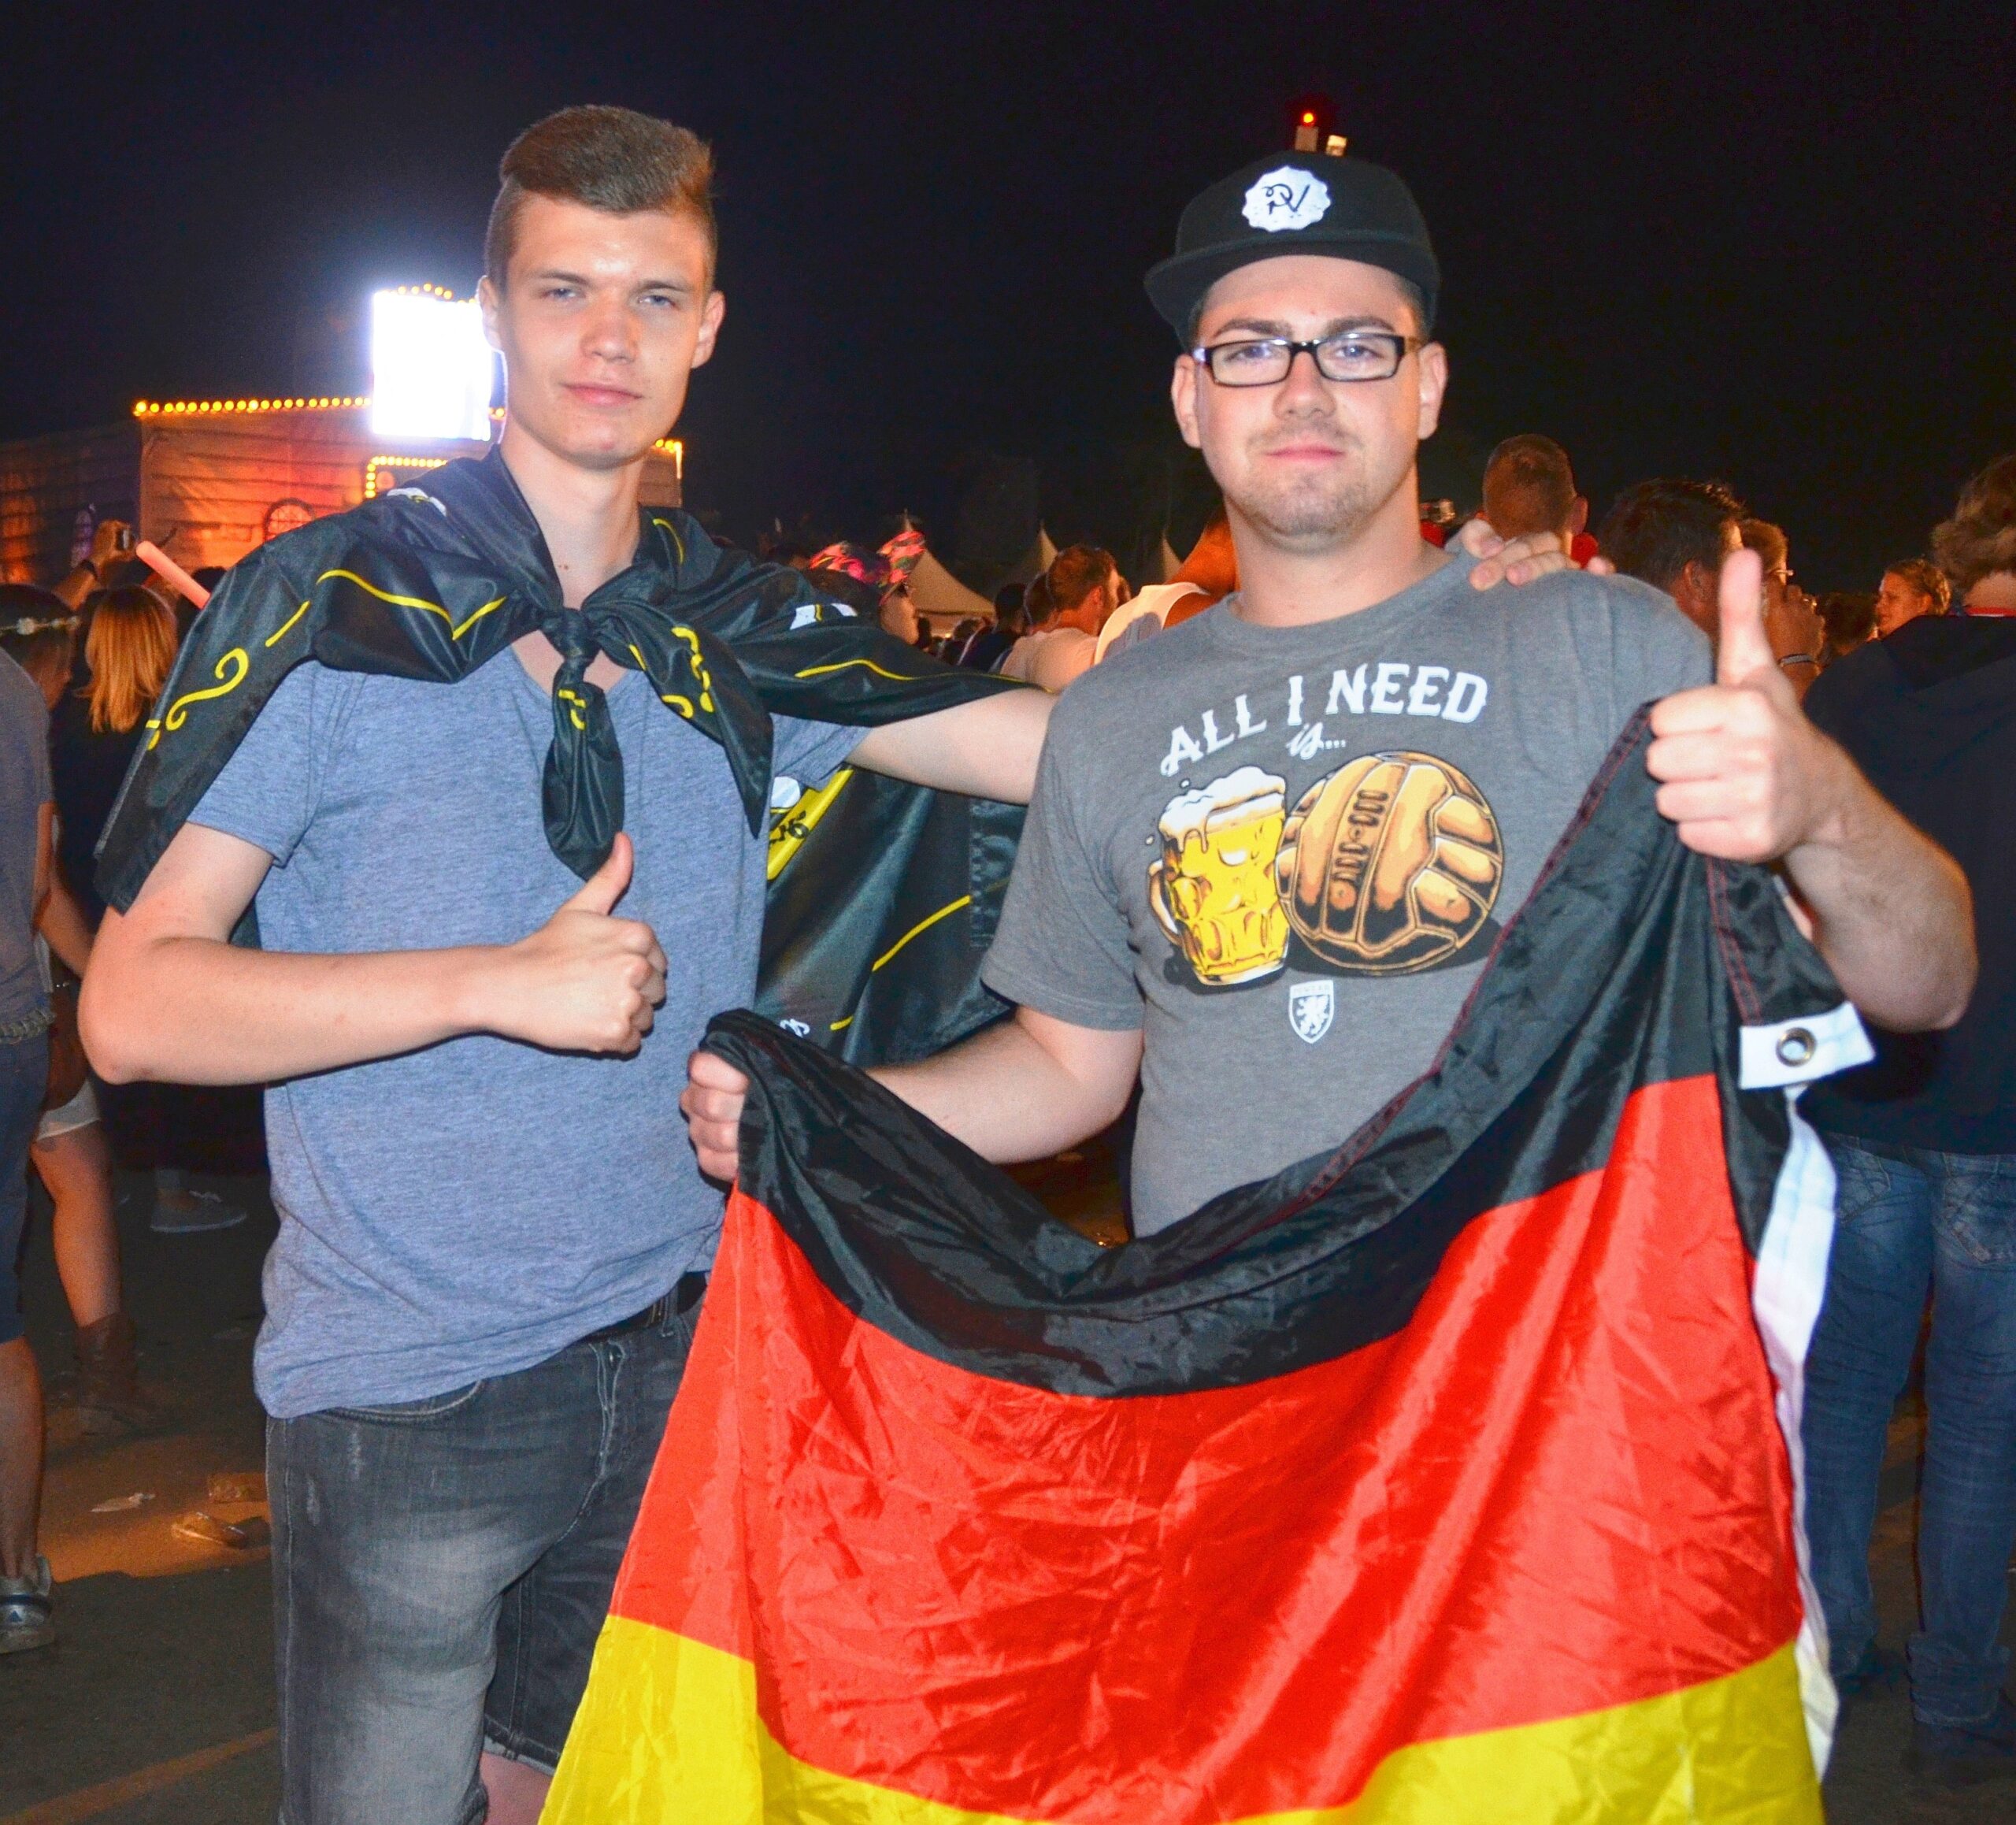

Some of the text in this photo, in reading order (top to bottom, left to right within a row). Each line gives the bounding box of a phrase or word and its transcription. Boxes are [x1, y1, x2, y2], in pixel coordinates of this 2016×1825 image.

[1160, 662, 1488, 777] ALL I NEED
